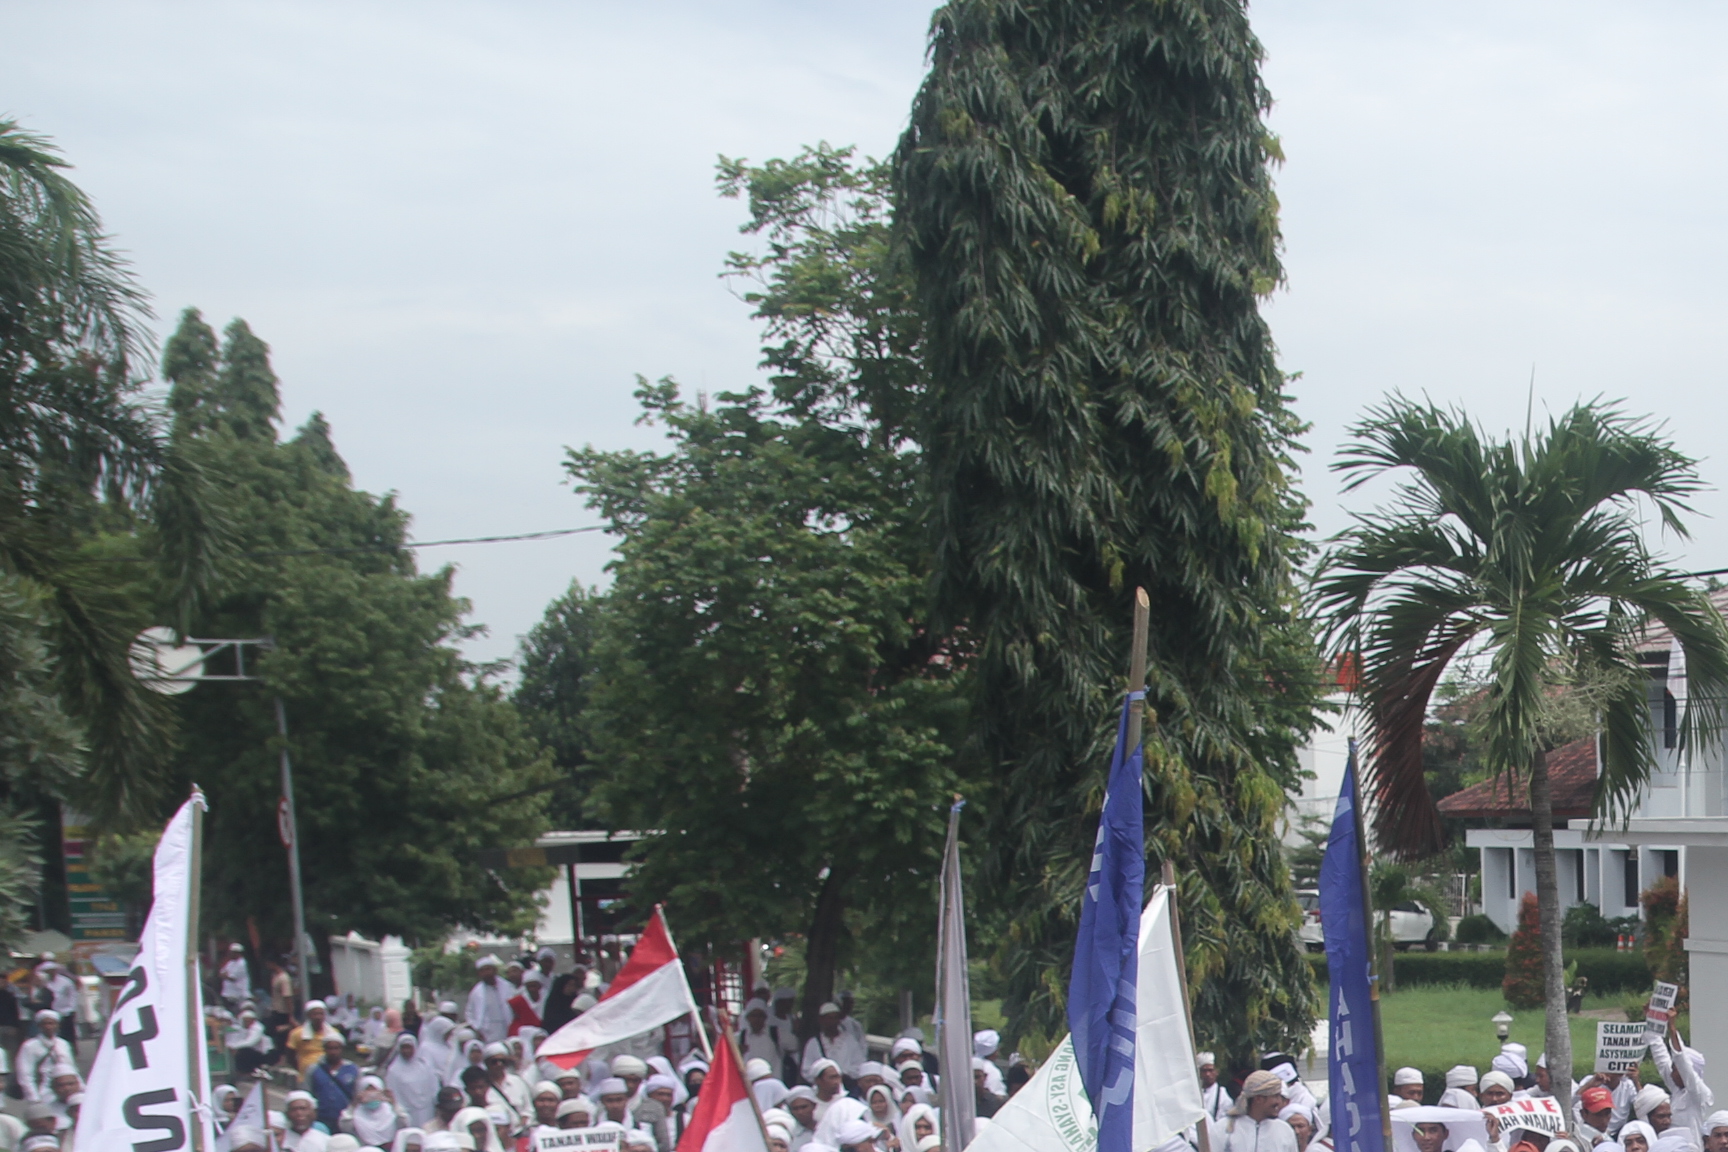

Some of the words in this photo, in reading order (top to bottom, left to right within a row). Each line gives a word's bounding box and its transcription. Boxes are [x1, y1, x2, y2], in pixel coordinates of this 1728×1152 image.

[1602, 1036, 1630, 1047] TANAH
[1632, 1037, 1645, 1047] MA
[1497, 1099, 1558, 1115] AVE
